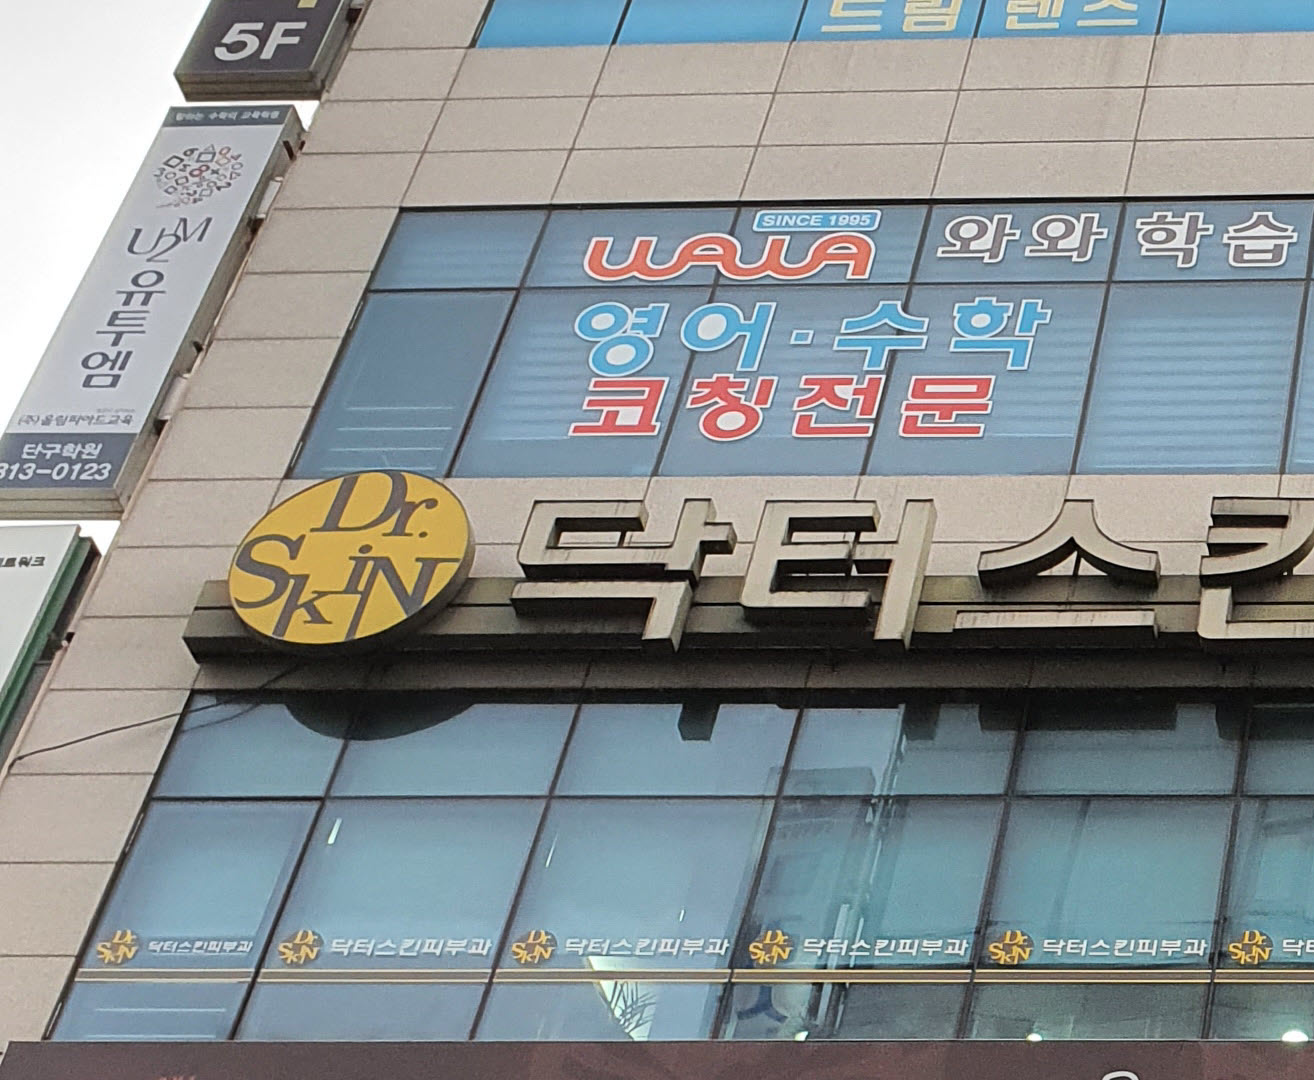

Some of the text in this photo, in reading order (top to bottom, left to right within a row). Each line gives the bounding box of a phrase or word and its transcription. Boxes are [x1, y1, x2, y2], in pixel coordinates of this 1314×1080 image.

[213, 20, 308, 62] 5F
[761, 212, 872, 229] SINCE 1995
[81, 270, 167, 388] 유투엠
[311, 471, 438, 538] Dr.
[148, 940, 253, 954] 닥터스킨피부과
[330, 938, 492, 957] 닥터스킨피부과
[564, 938, 731, 956] 닥터스킨피부과
[803, 938, 969, 957] 닥터스킨피부과
[1042, 938, 1208, 957] 닥터스킨피부과
